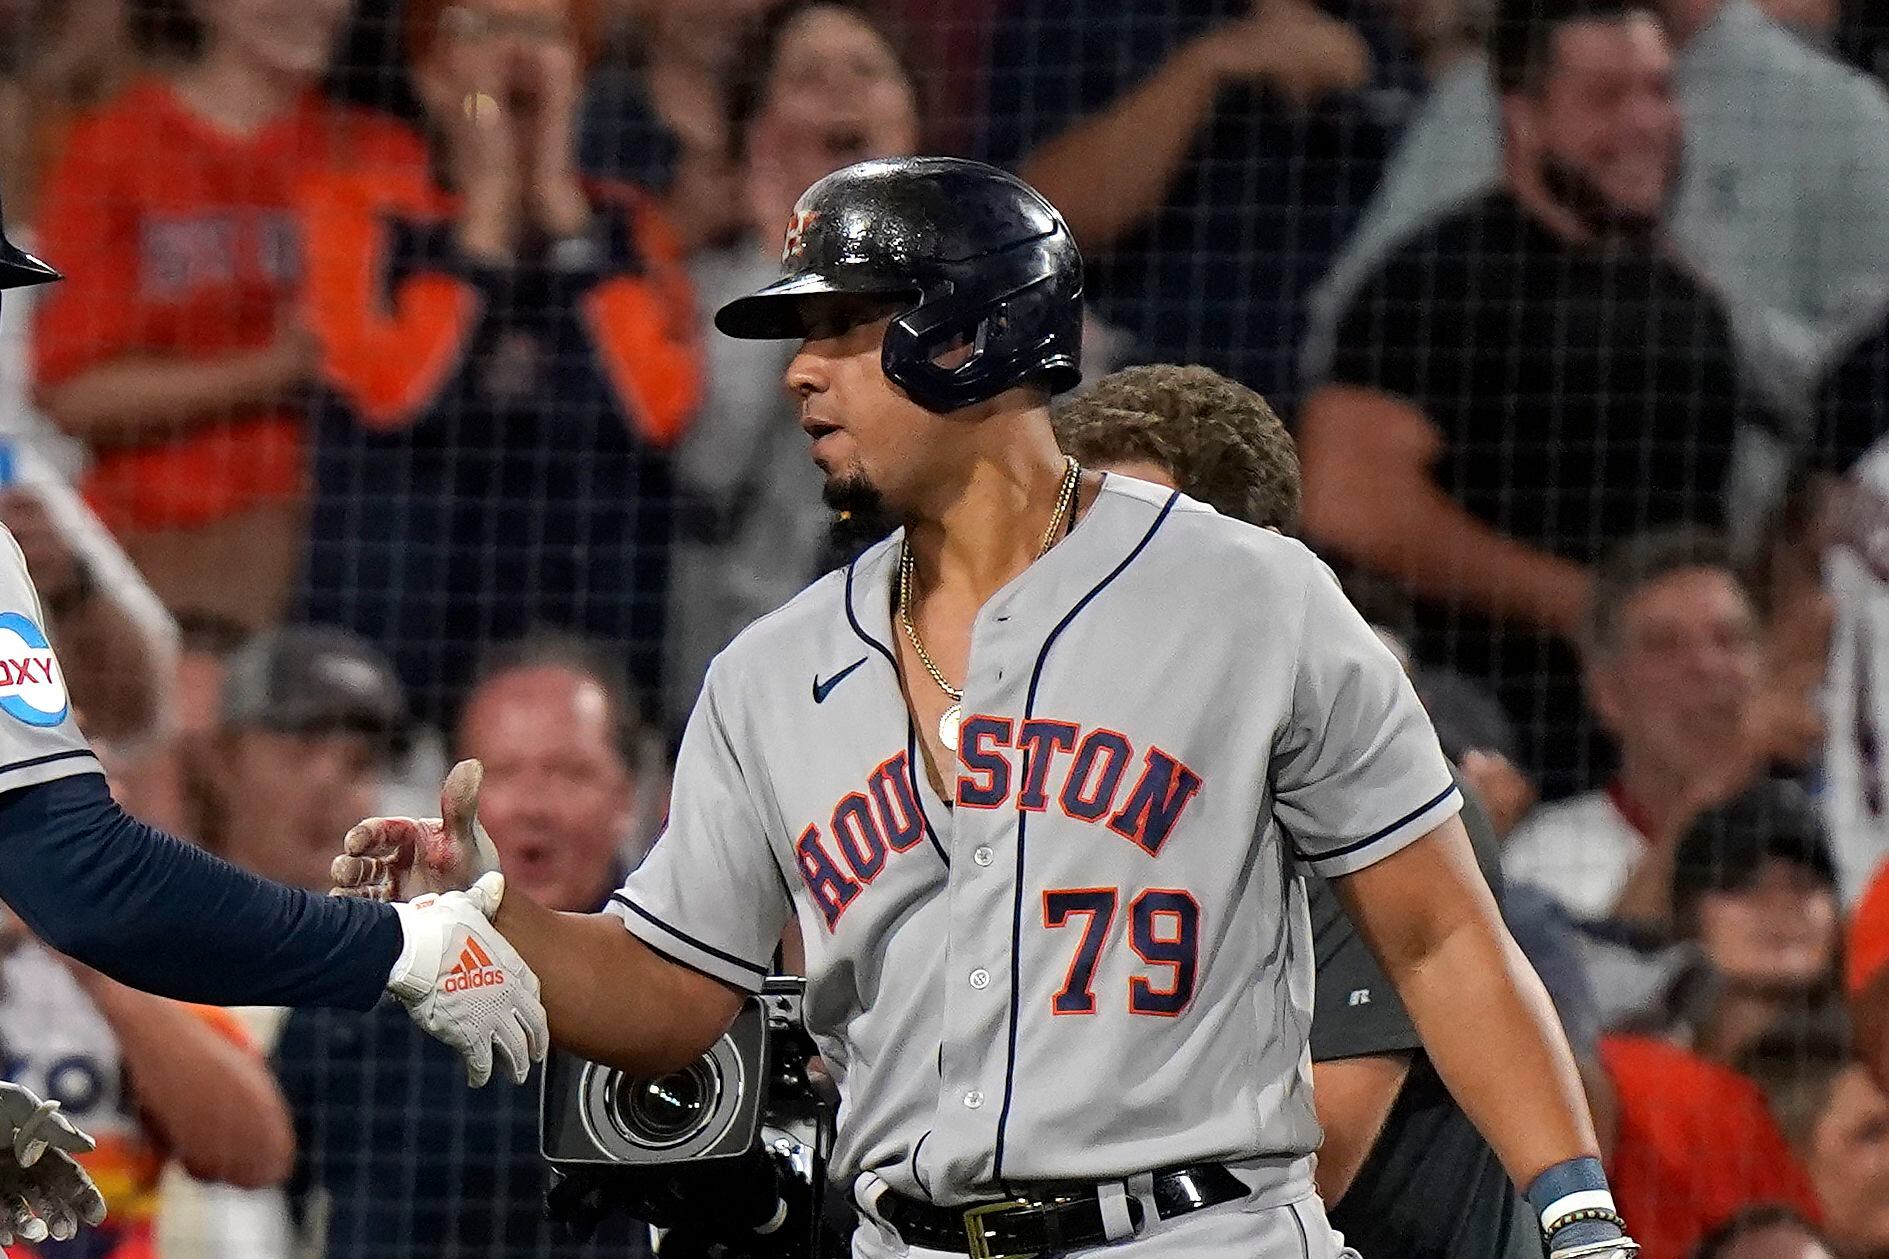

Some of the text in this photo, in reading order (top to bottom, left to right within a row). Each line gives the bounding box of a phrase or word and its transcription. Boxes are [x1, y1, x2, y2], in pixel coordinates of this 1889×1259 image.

[796, 714, 1204, 935] HOUSTON
[444, 969, 504, 993] adidas
[1043, 886, 1201, 1018] 79
